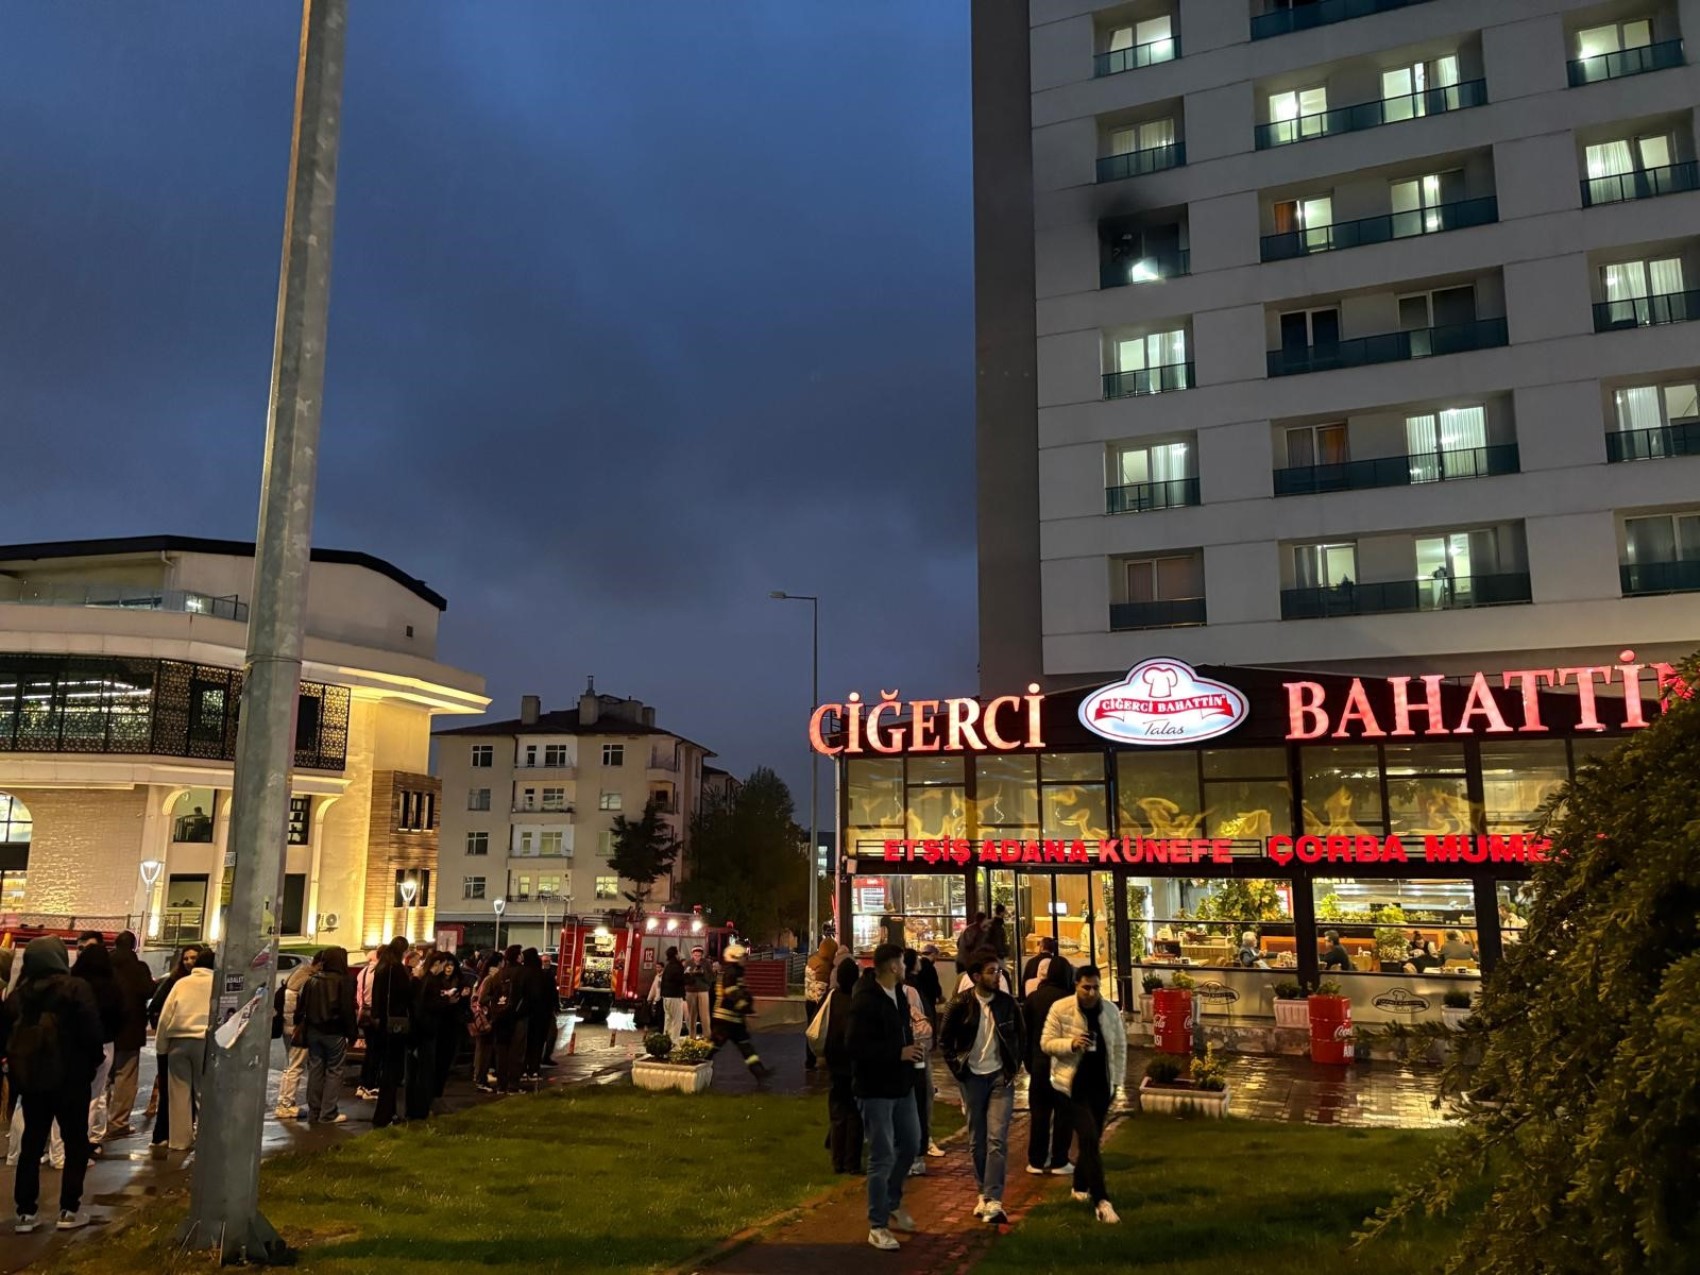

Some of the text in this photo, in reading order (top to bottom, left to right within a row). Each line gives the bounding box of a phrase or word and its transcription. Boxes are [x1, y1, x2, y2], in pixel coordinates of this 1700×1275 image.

[1102, 694, 1224, 713] CİĞERCİ BAHATTİN
[809, 683, 1046, 755] CİĞERCİ
[1142, 719, 1185, 736] Talas
[979, 839, 1089, 864] ADANA
[1100, 834, 1233, 864] KÜNEFE
[1268, 834, 1408, 866] ÇORBA
